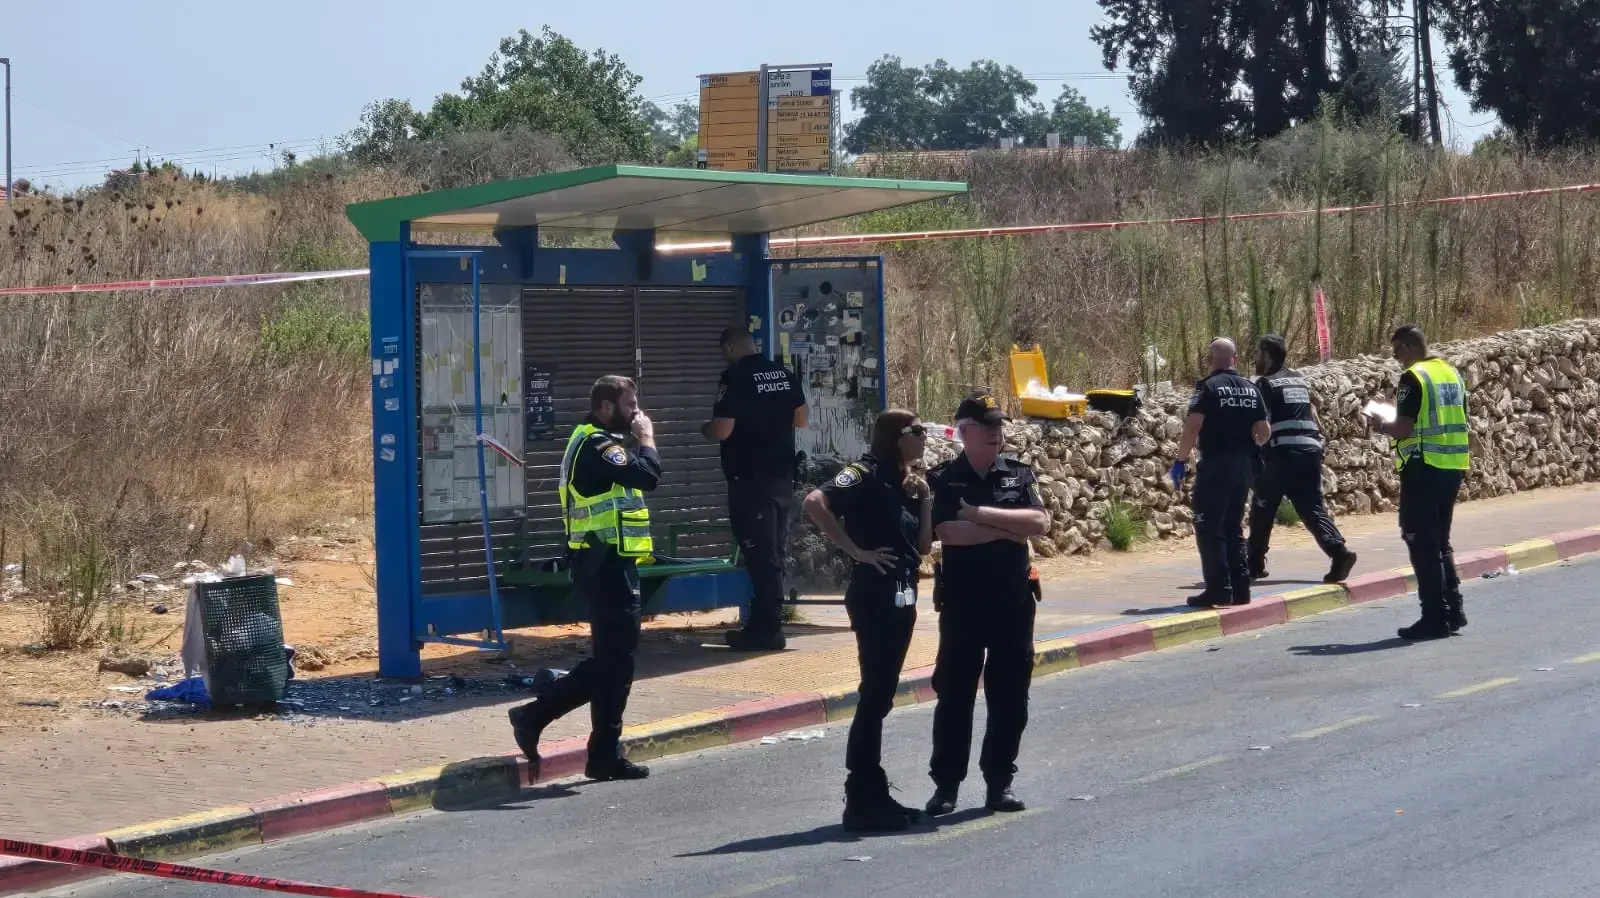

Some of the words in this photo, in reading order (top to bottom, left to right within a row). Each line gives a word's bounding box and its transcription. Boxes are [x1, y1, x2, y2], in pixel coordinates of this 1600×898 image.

[753, 370, 787, 382] משטרה
[757, 381, 791, 394] POLICE
[1217, 386, 1257, 398] משטרה
[1220, 398, 1257, 409] POLICE
